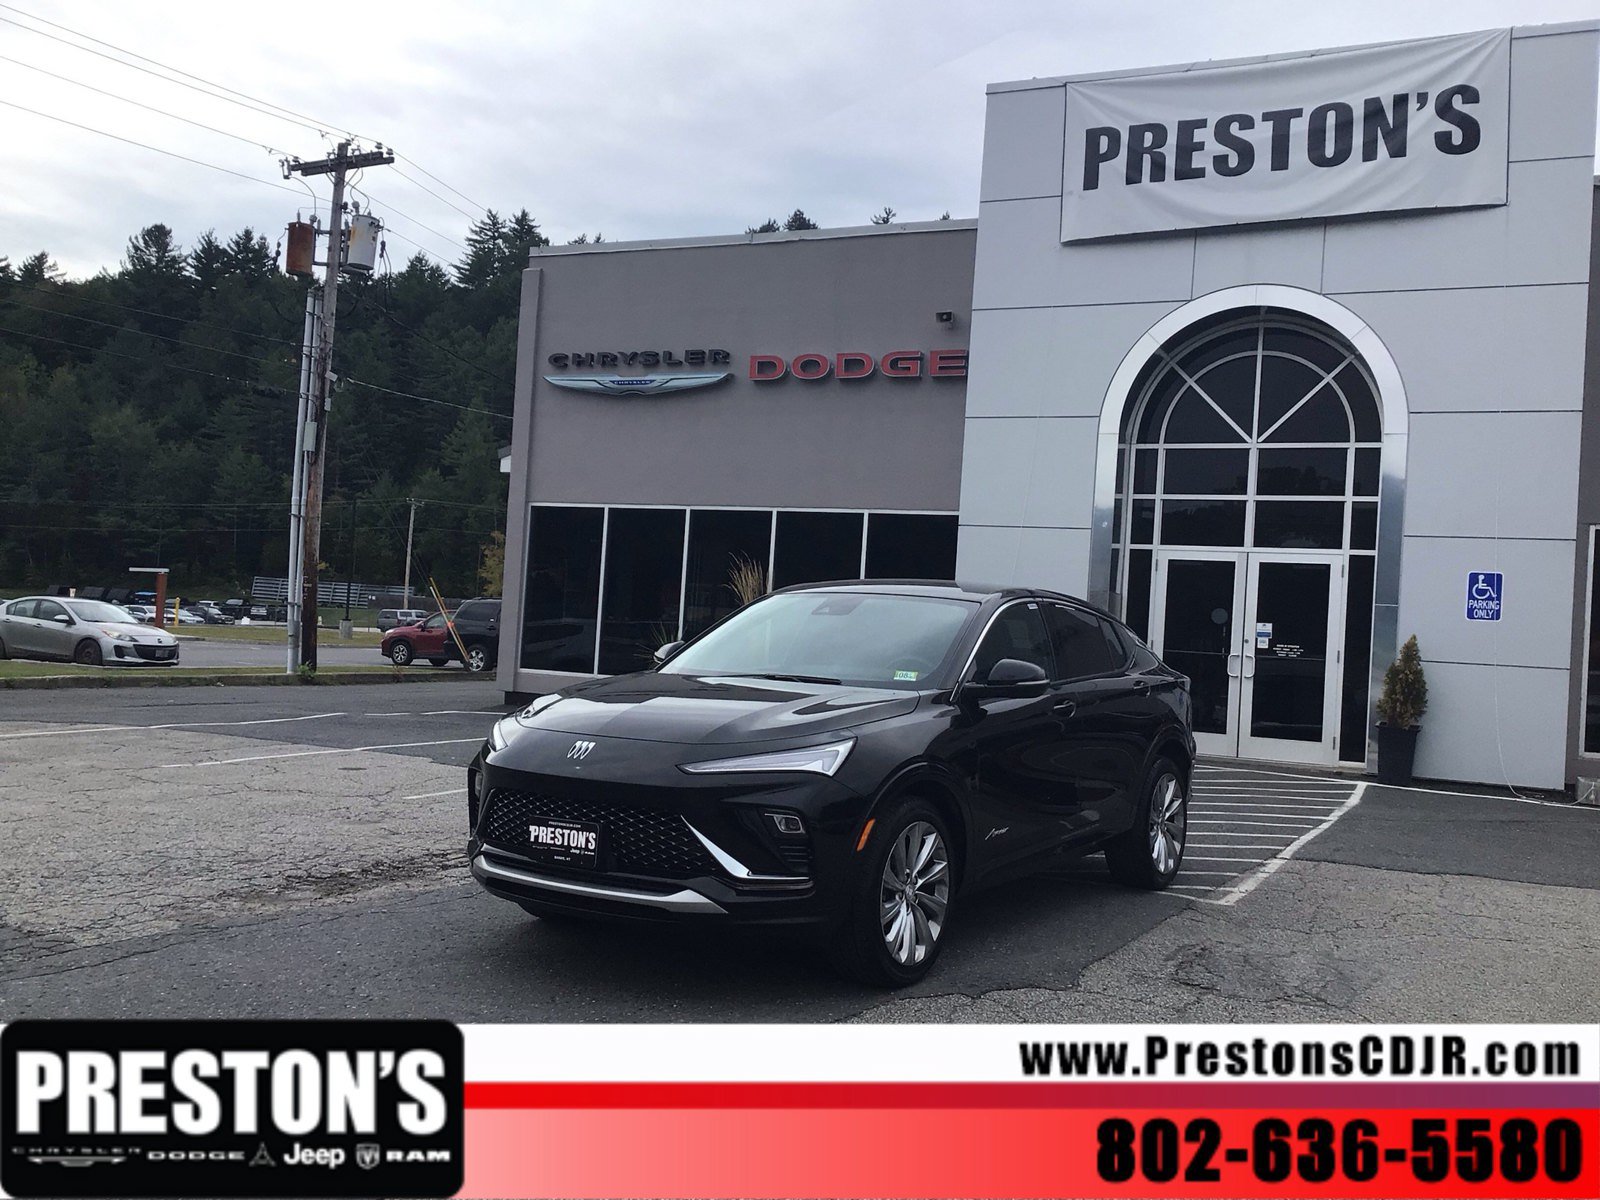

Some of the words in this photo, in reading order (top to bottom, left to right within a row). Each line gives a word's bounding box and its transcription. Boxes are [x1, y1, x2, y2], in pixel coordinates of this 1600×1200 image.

[1083, 84, 1481, 191] PRESTON'S
[548, 349, 731, 368] CHRYSLER
[749, 349, 967, 381] DODGE
[1468, 599, 1500, 610] PARKING
[1473, 608, 1494, 619] ONLY
[529, 825, 596, 850] PRESTON'S
